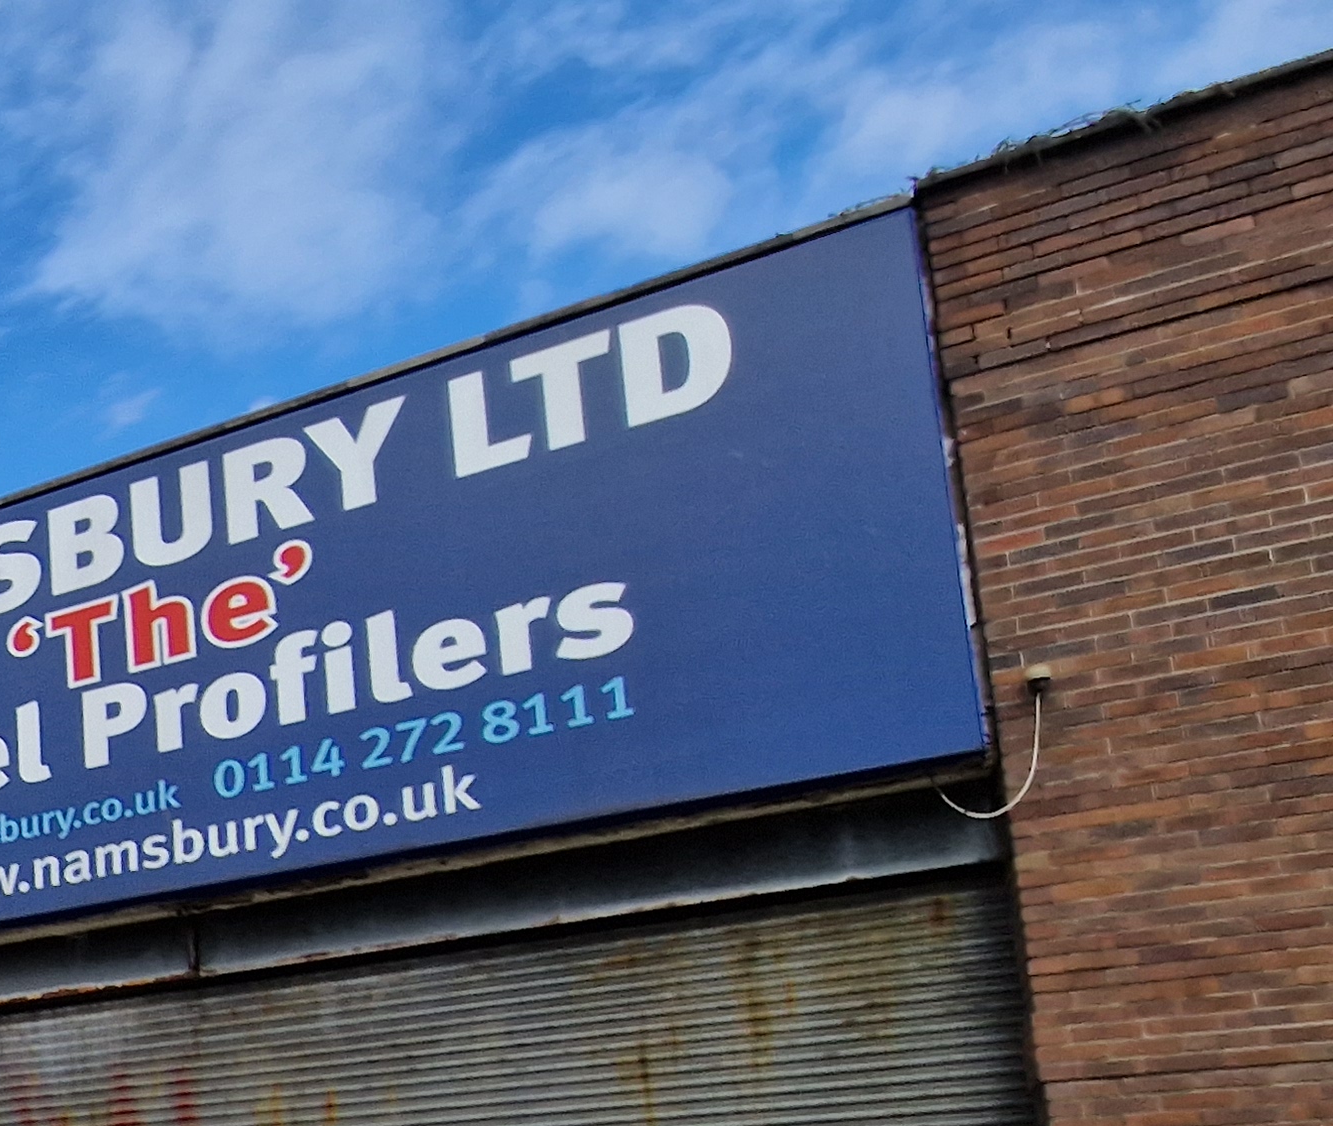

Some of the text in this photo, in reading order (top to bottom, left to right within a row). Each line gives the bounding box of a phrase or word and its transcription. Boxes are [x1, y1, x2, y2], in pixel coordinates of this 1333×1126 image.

[447, 304, 732, 479] LTD
[80, 581, 635, 769] Profilers
[213, 675, 635, 799] 0114 272 8111
